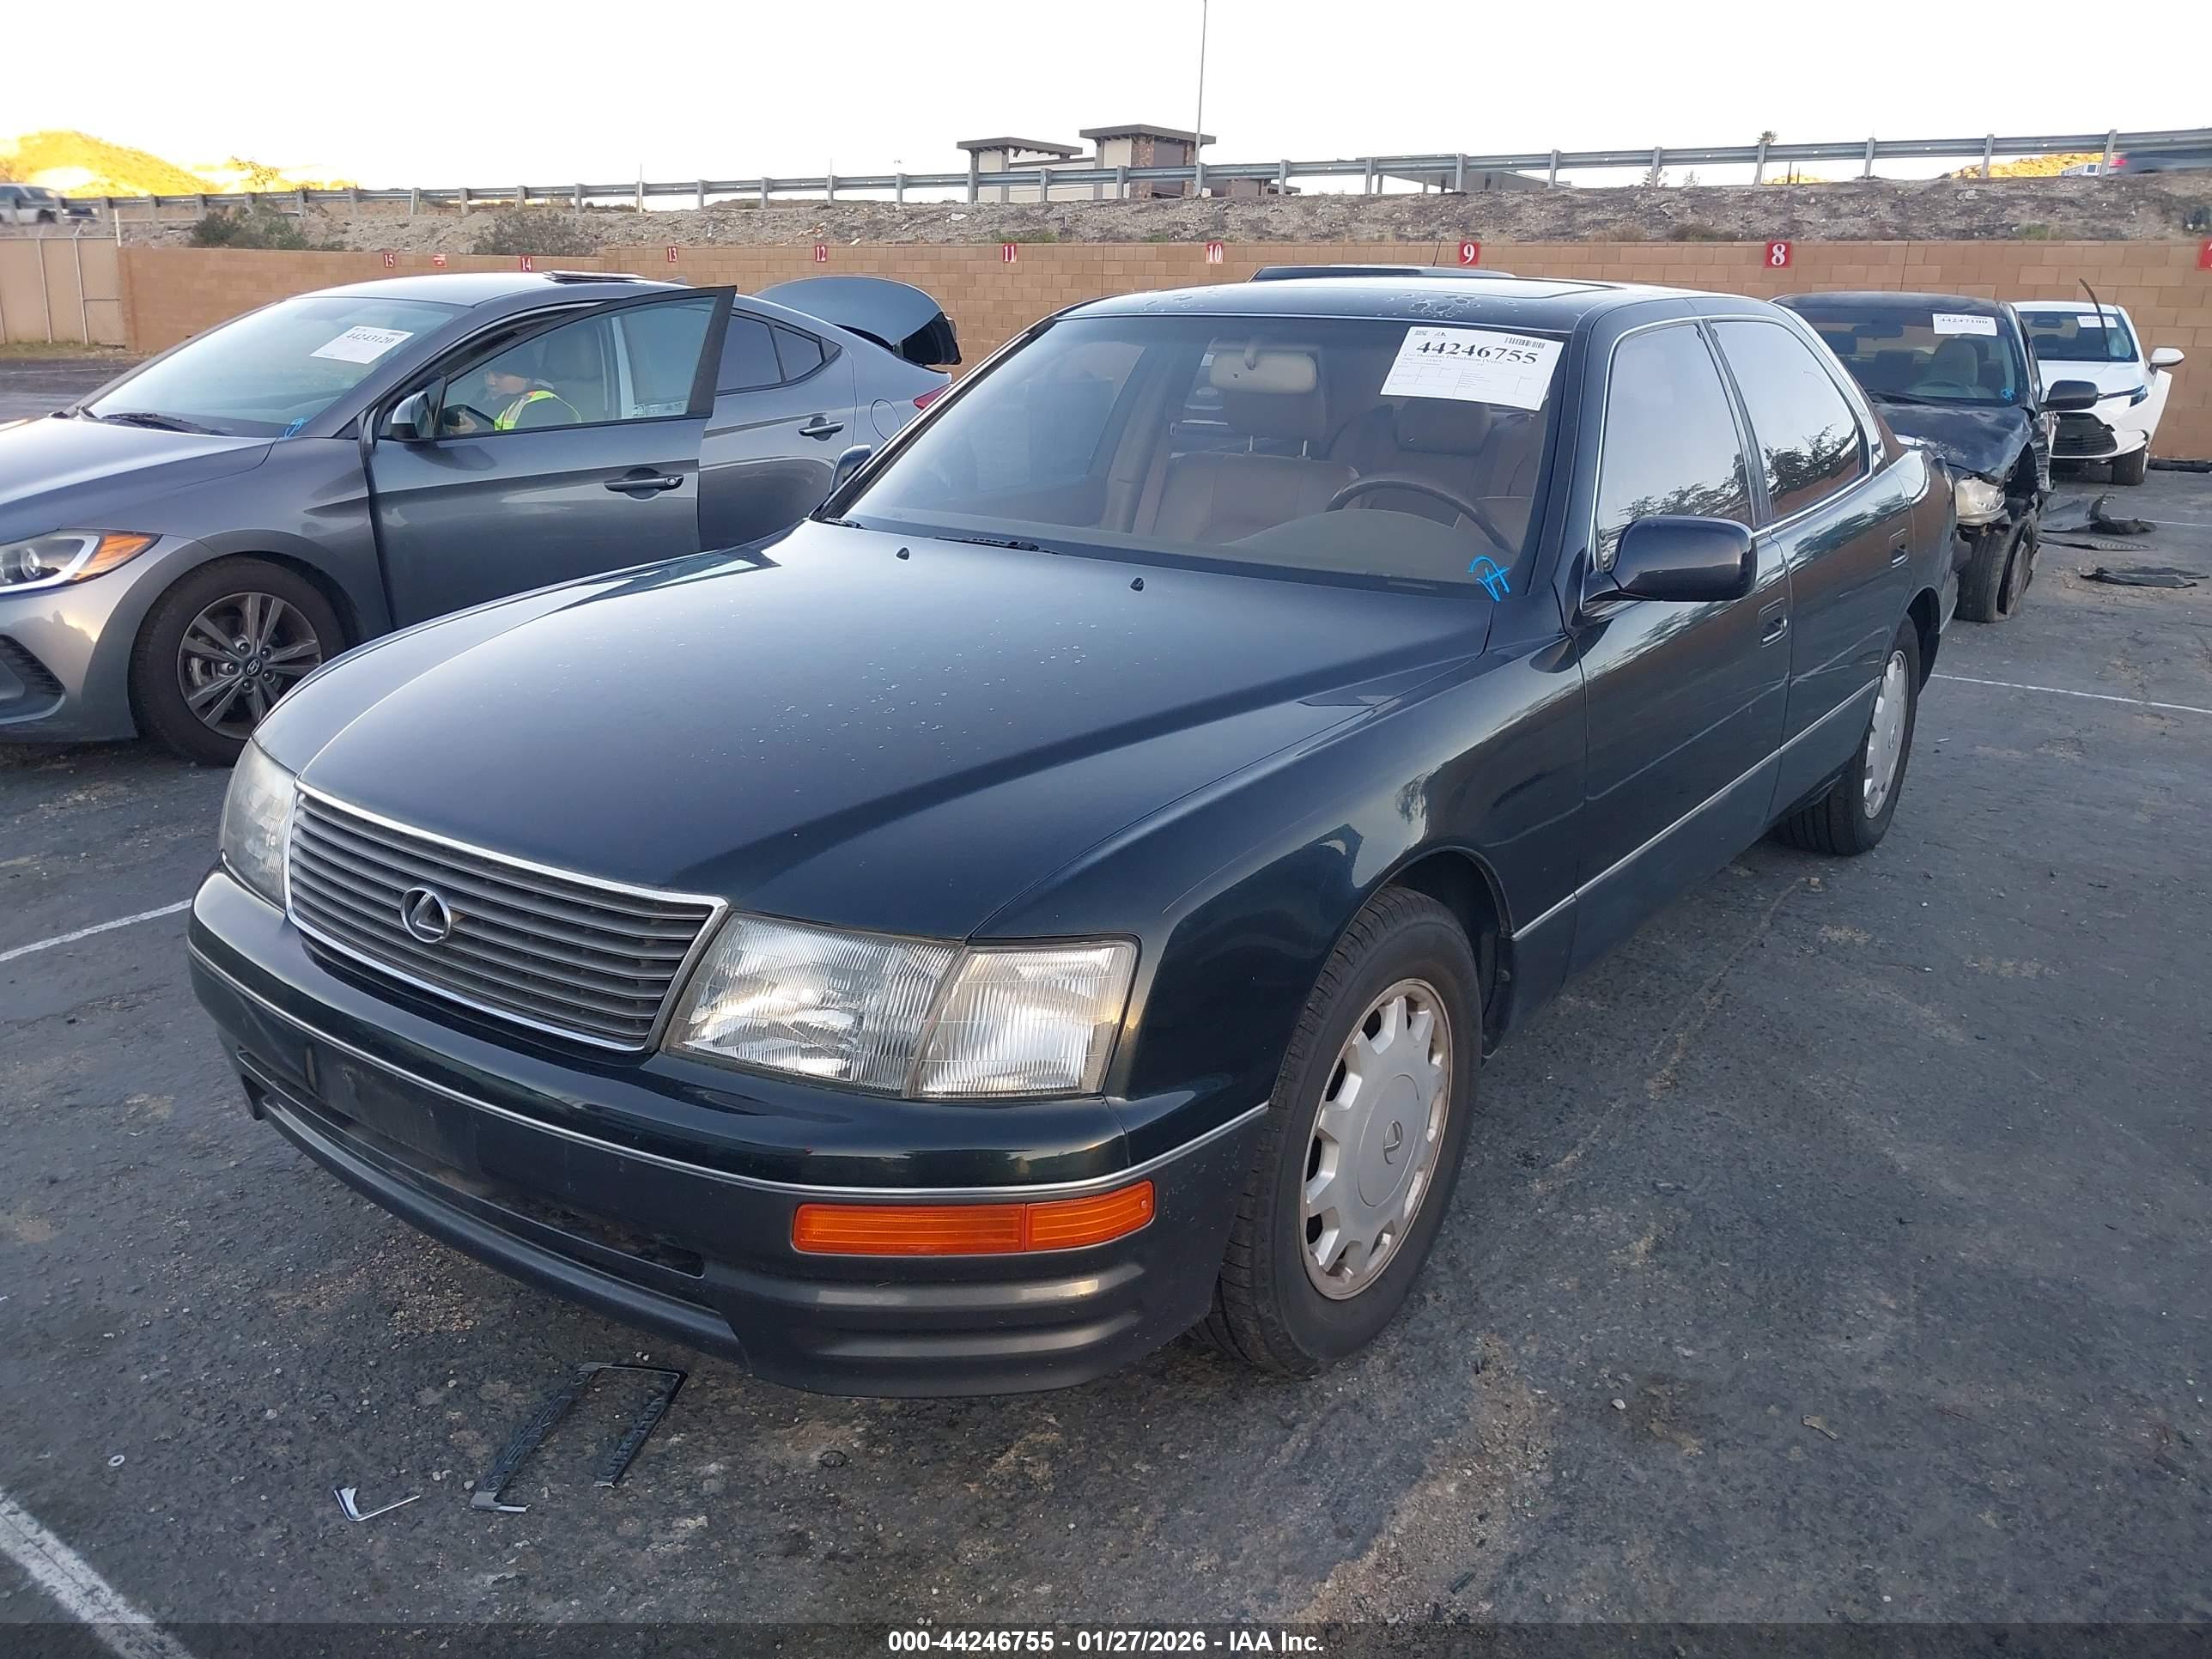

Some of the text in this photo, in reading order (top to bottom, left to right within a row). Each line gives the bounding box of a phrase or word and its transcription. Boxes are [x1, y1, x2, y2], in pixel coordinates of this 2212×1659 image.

[384, 253, 394, 268] 15
[667, 246, 678, 262] 13
[816, 246, 826, 262] 12
[1003, 244, 1017, 264] 11
[1208, 244, 1223, 263] 10
[1462, 244, 1475, 264] 9
[1771, 243, 1786, 266] 8
[520, 256, 532, 271] 14
[1416, 341, 1539, 365] 44246755
